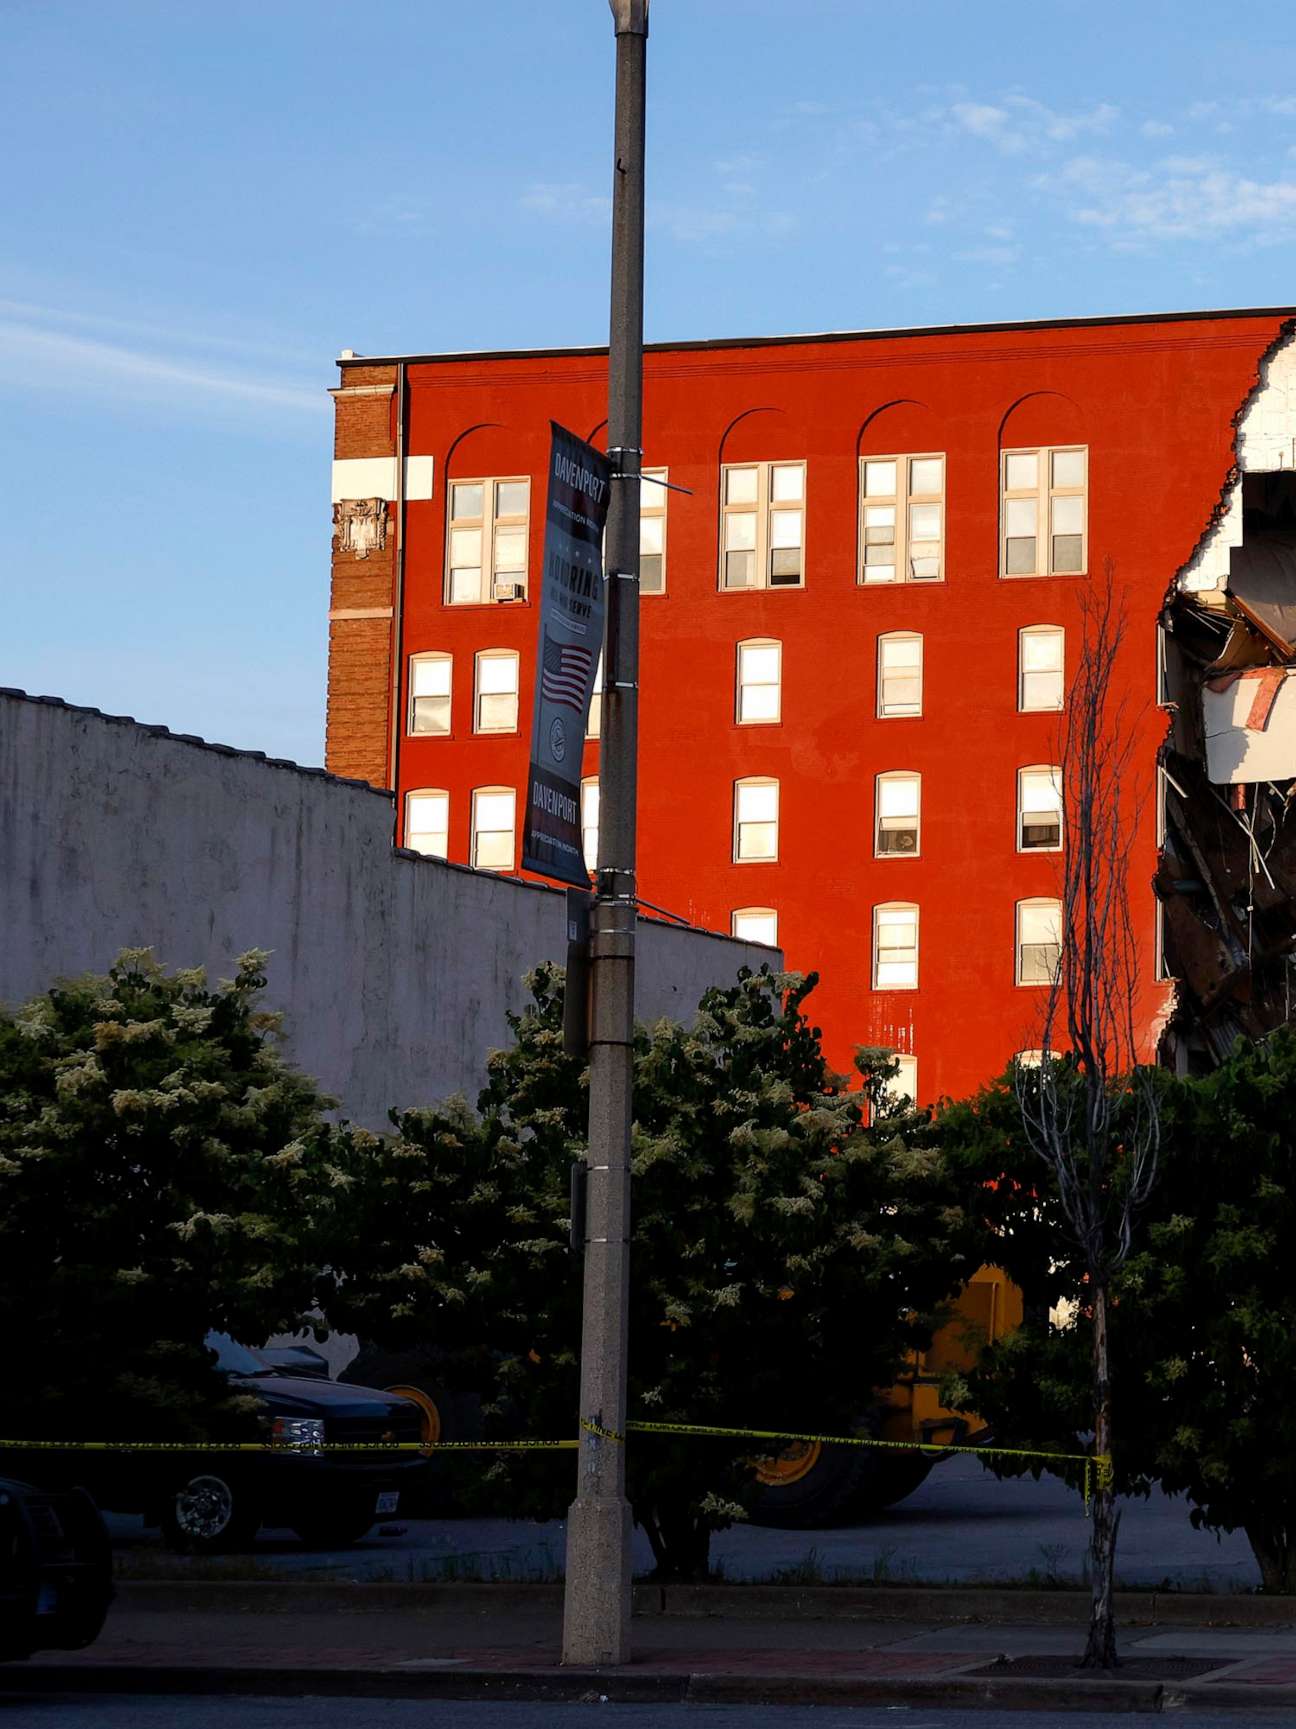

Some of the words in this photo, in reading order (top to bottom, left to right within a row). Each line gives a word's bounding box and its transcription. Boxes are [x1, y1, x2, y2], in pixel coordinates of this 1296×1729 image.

[554, 452, 606, 504] DAVENPORT
[568, 598, 592, 618] SERVE
[532, 780, 577, 825] DAVENPORT
